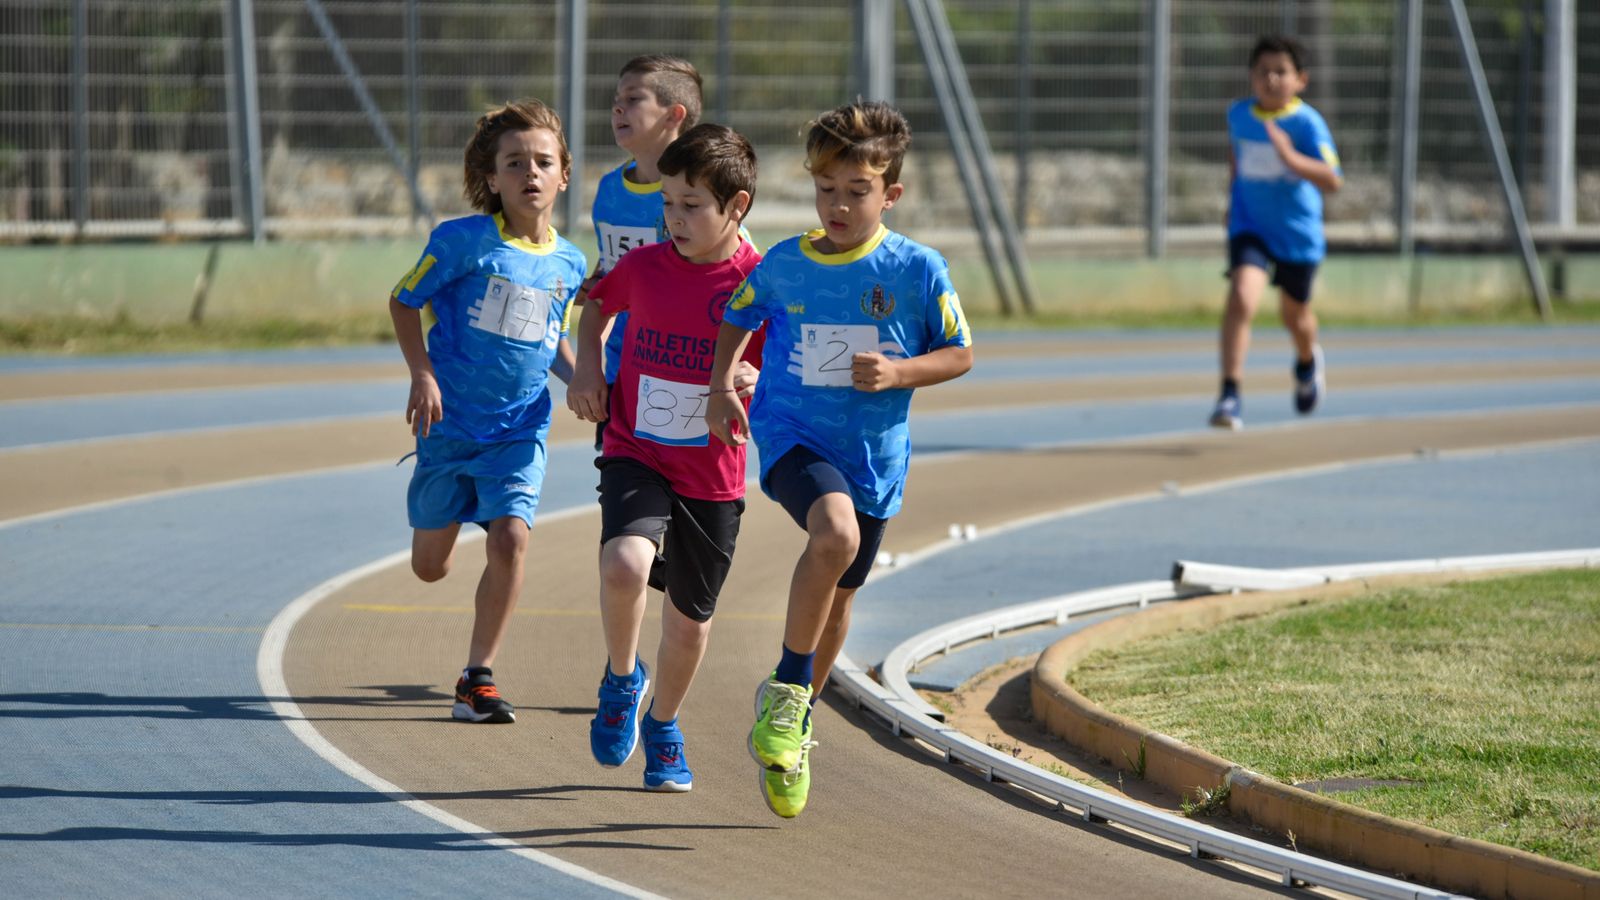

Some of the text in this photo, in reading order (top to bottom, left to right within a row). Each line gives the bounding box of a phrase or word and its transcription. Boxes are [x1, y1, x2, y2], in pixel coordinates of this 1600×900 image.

[498, 292, 540, 338] 17
[635, 326, 717, 356] ATLETIS
[818, 340, 852, 372] 2
[643, 389, 706, 429] 87
